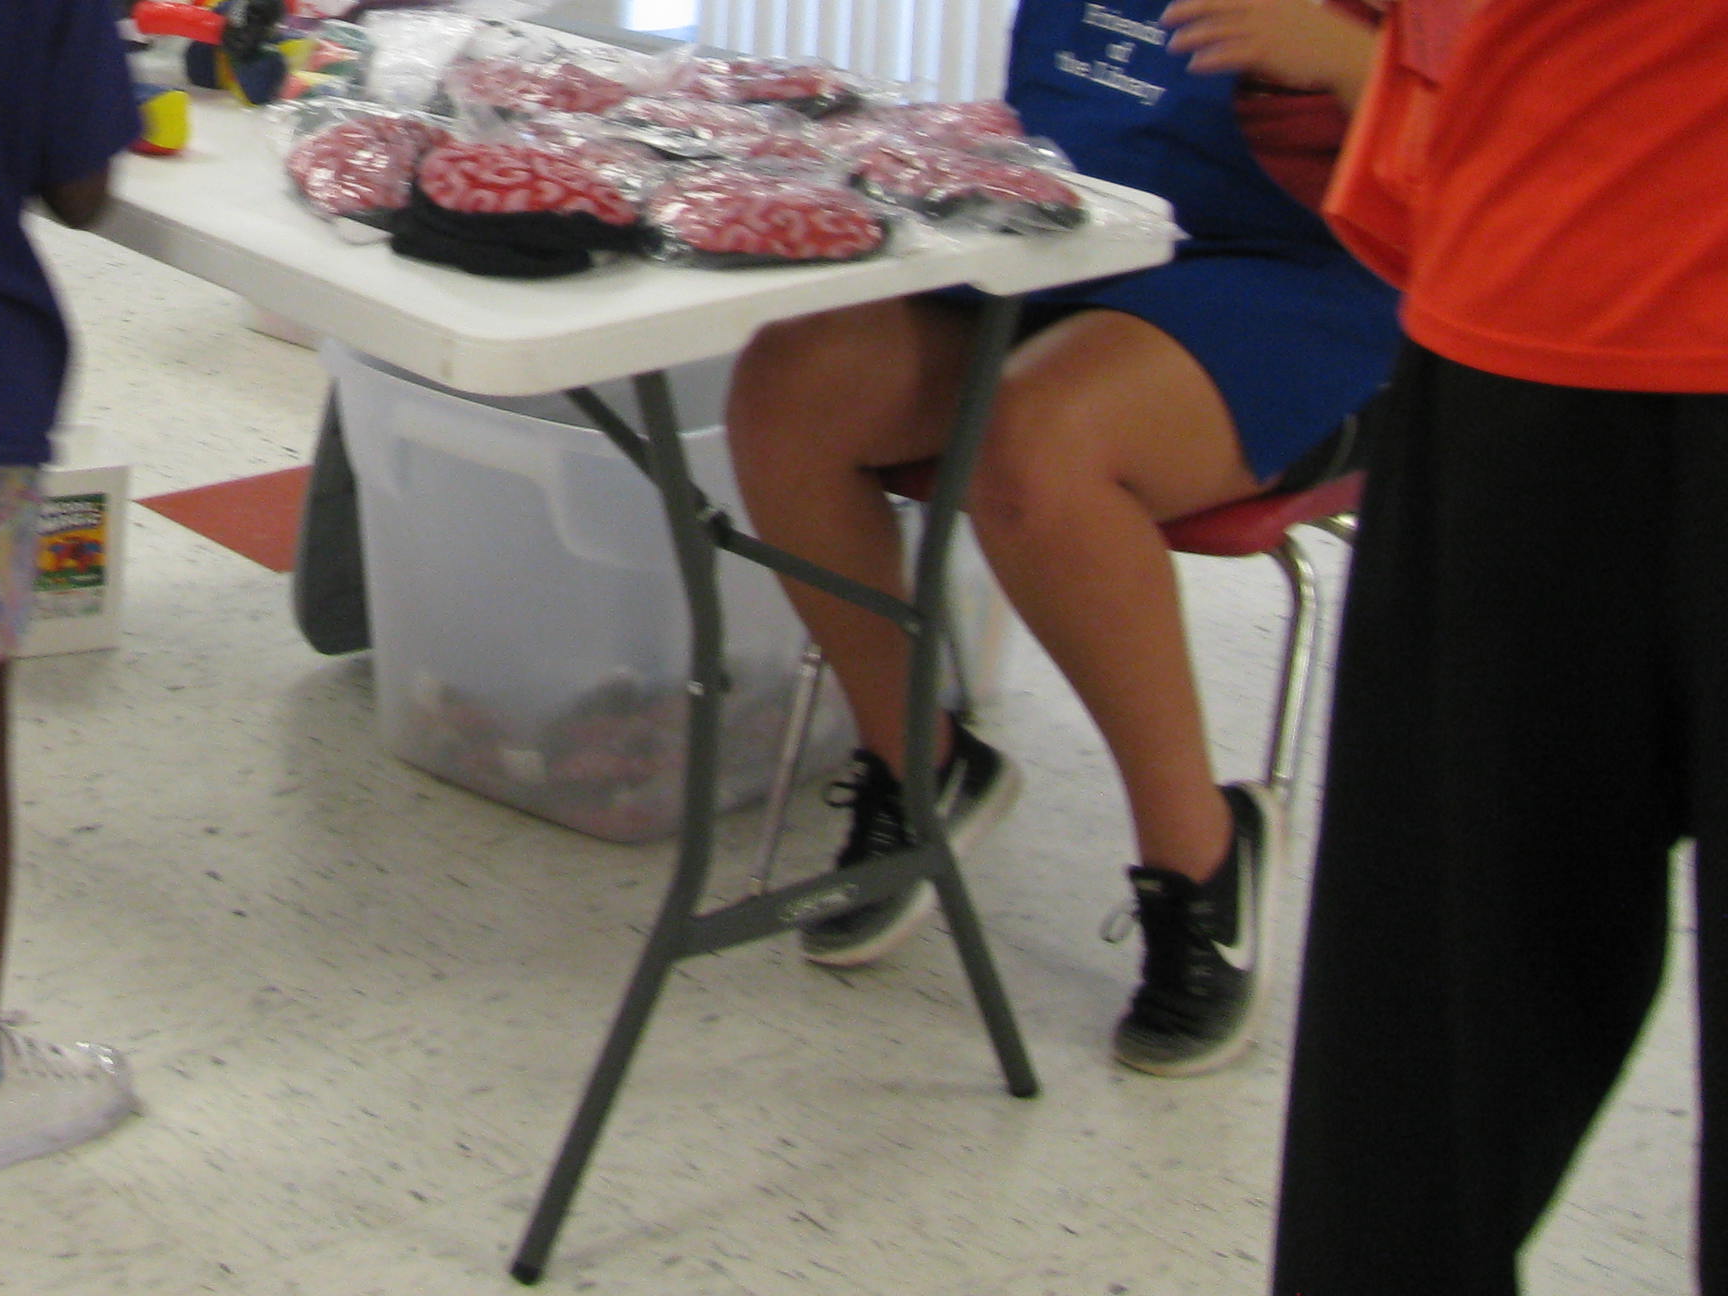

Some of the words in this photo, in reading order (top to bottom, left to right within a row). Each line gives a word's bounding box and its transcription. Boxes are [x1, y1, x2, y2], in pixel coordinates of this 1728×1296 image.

[1081, 2, 1168, 46] Friends
[1105, 41, 1137, 64] of
[1054, 51, 1092, 78] the
[1091, 60, 1168, 106] Library
